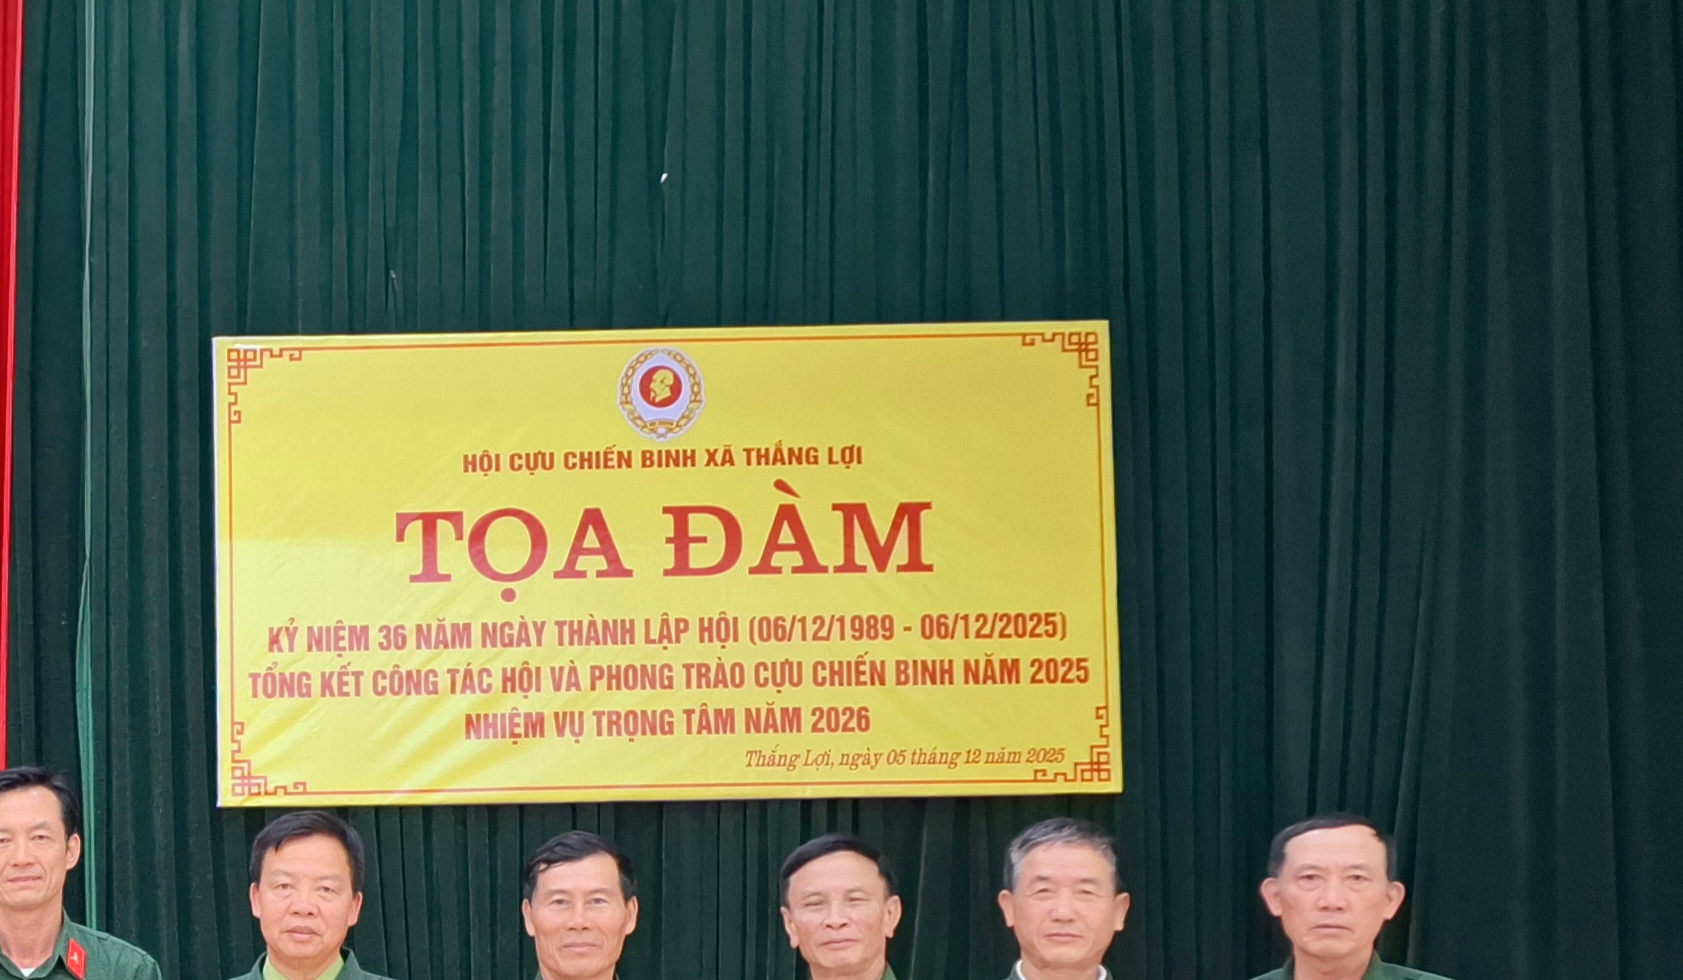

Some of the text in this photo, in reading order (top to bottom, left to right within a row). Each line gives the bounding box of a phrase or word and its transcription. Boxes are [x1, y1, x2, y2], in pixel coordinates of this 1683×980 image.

[463, 441, 862, 475] HỘI CỰU CHIẾN BINH XÃ THẮNG LỢI
[396, 480, 934, 601] TỌA ĐÀM
[269, 617, 298, 653] KỶ
[307, 620, 370, 657] NIỆM
[379, 624, 408, 651] 36
[416, 618, 472, 649] NĂM
[481, 616, 546, 648] NGÀY
[555, 614, 636, 646] THÀNH
[645, 612, 690, 650] LẬP
[699, 611, 739, 649] HỘI
[749, 615, 895, 645] (06/12/1989
[921, 612, 1066, 641] 06/12/2025)
[250, 651, 1090, 699] TỔNG KẾT CÔNG TÁC HỘI VÀ PHONG TRÀO CỰU CHIẾN BINH NĂM 2025
[465, 702, 871, 745] NHIỆM VỤ TRỌNG TÂM NĂM 2026
[745, 744, 800, 771] Thắng
[838, 749, 882, 770] ngày
[886, 750, 907, 766] 05
[910, 747, 963, 769] tháng
[964, 749, 982, 765] 12
[984, 749, 1023, 764] năm
[1025, 748, 1066, 764] 2025
